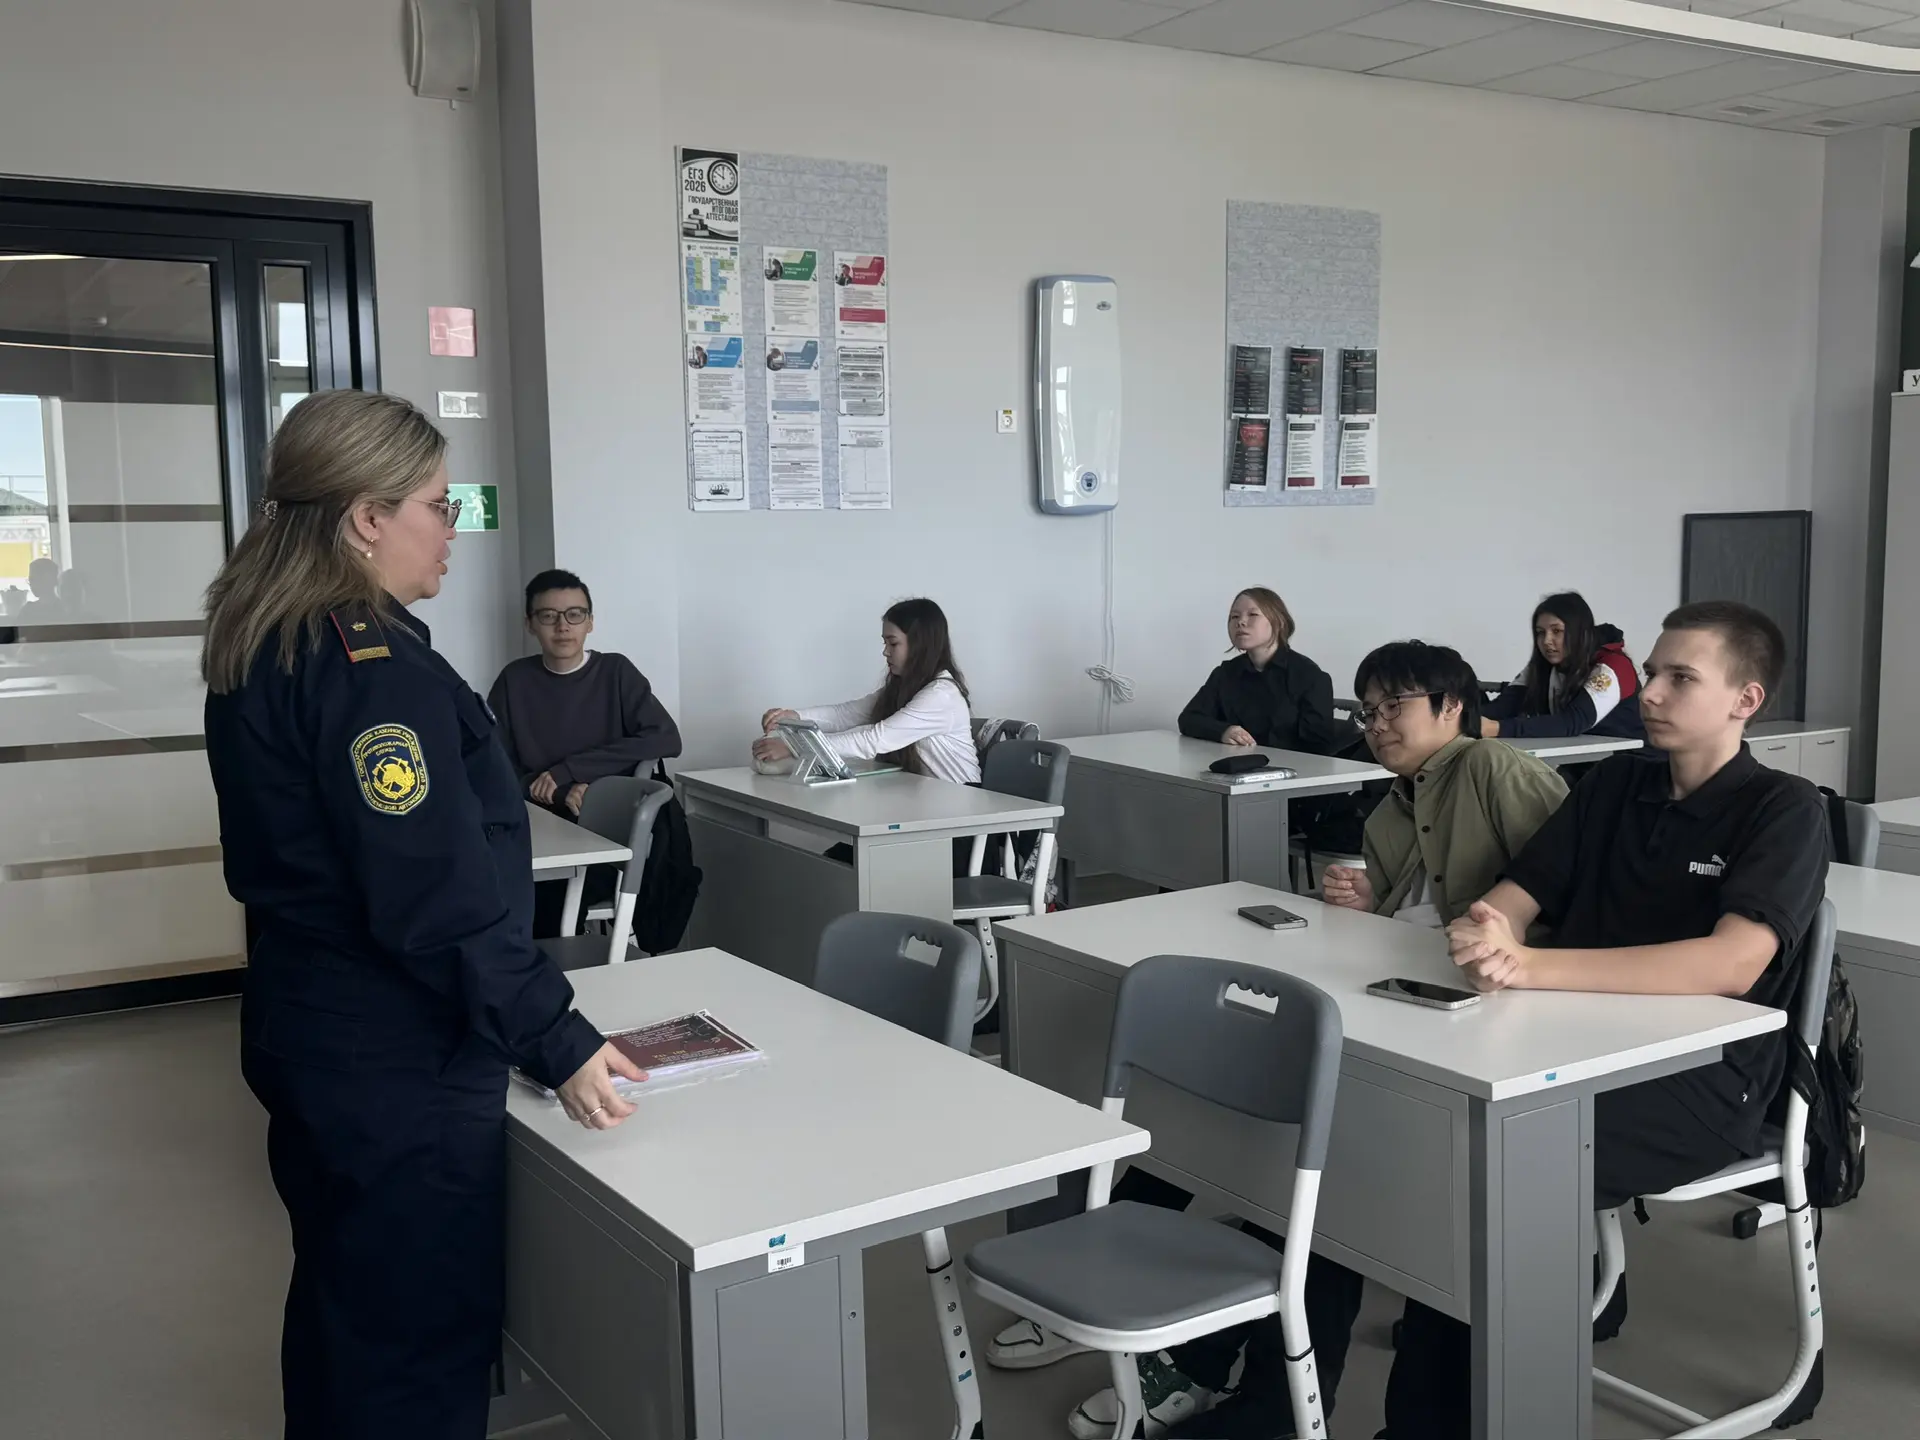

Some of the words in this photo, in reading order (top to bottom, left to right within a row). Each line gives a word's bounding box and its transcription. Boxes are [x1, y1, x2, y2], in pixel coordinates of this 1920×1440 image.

[688, 167, 704, 180] ЕГЭ
[684, 179, 706, 193] 2026
[688, 195, 738, 206] ГОСУДАРСТВЕННАЯ
[712, 205, 738, 214] ИТОГОВАЯ
[706, 212, 738, 222] АТТЕСТАЦИЯ
[376, 747, 396, 756] СЛУЖБА
[1688, 861, 1722, 877] PUMA
